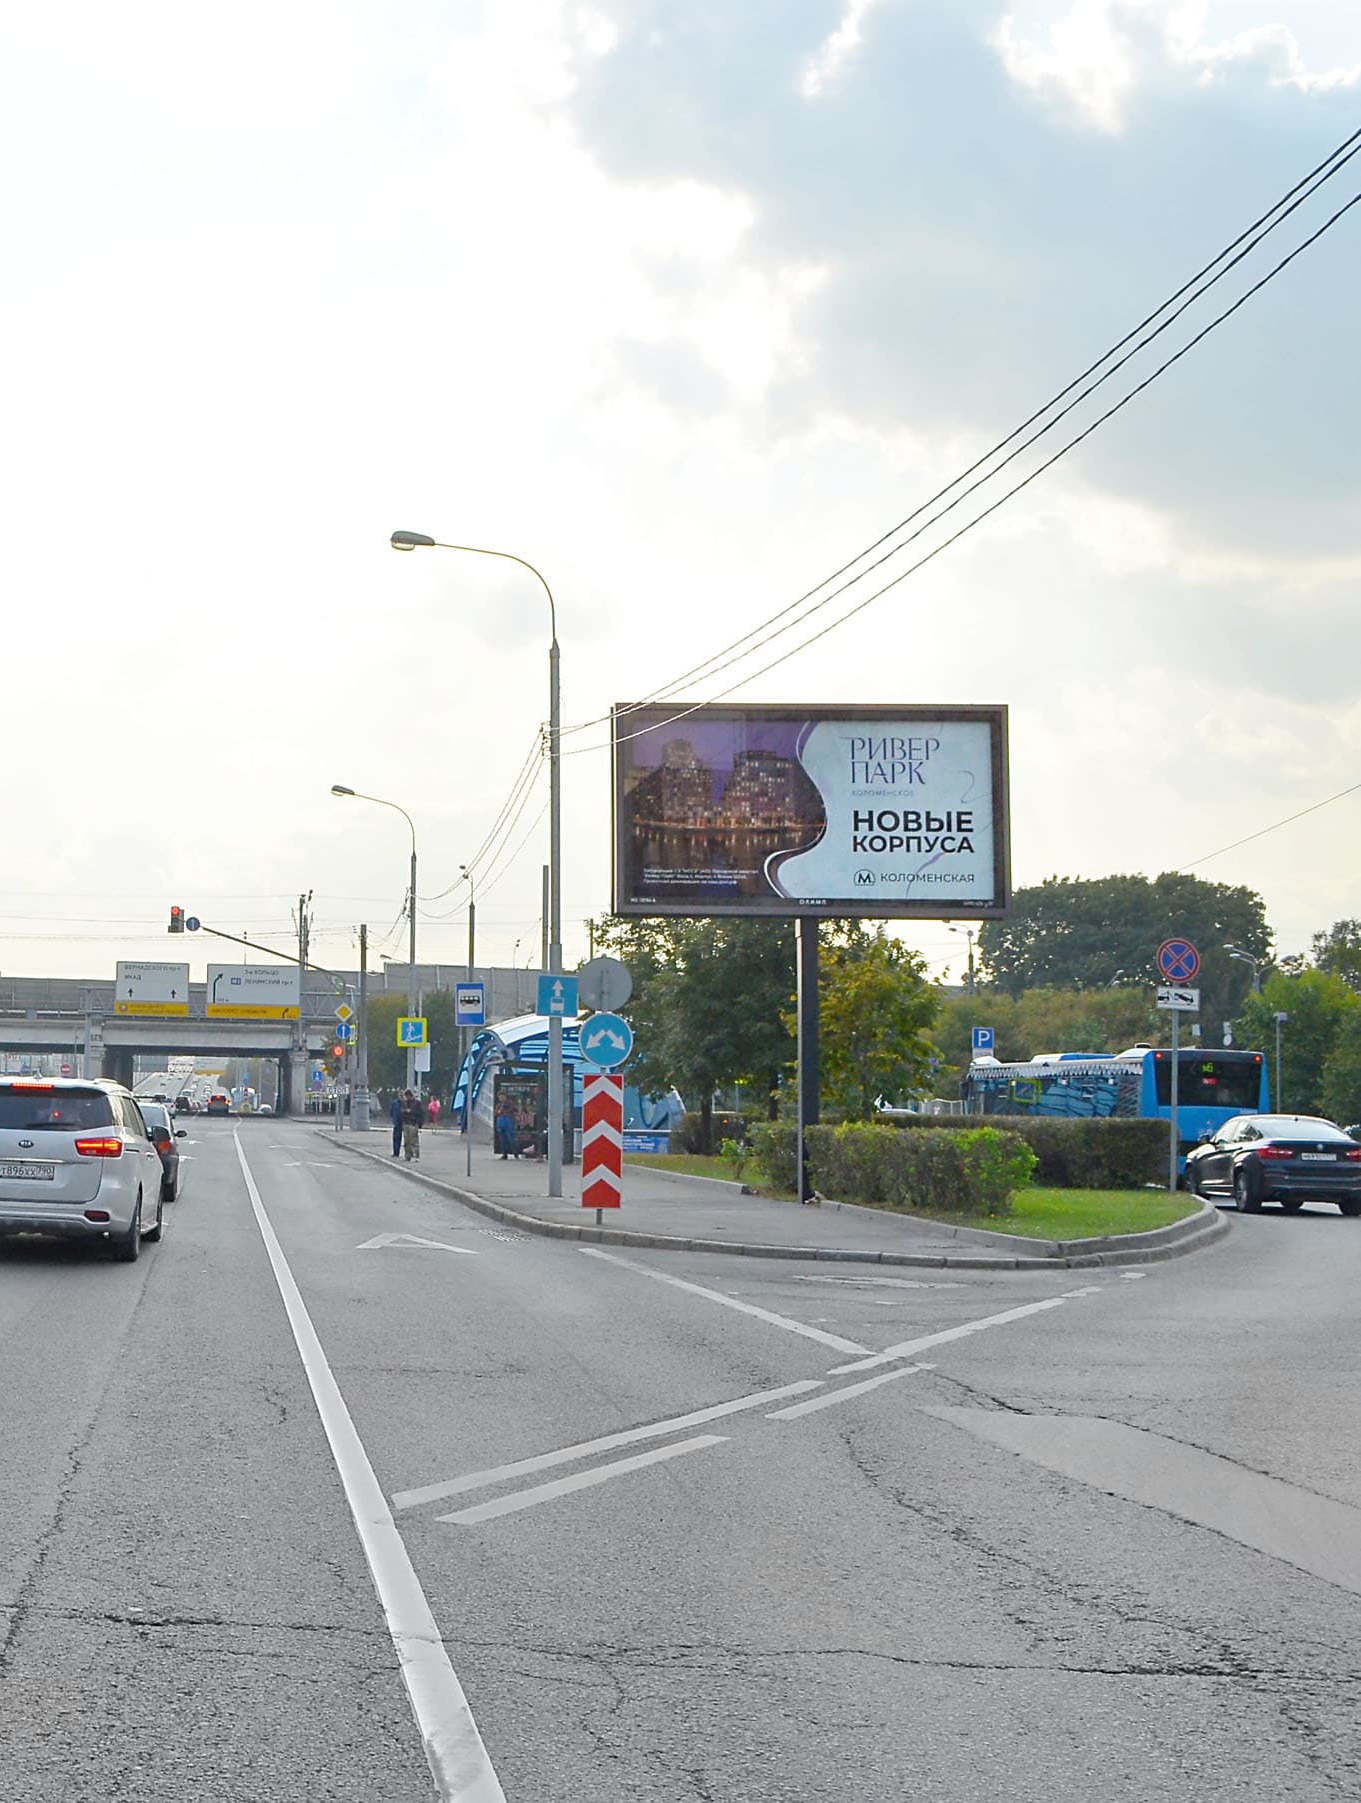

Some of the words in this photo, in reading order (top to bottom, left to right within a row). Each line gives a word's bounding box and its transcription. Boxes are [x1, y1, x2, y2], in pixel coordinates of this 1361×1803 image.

[850, 737, 940, 760] РИВЕР
[850, 761, 926, 784] ПАРК
[852, 810, 974, 832] НОВЫЕ
[852, 835, 975, 853] КОРПУСА
[880, 873, 975, 883] КОЛОМЕНСКАЯ
